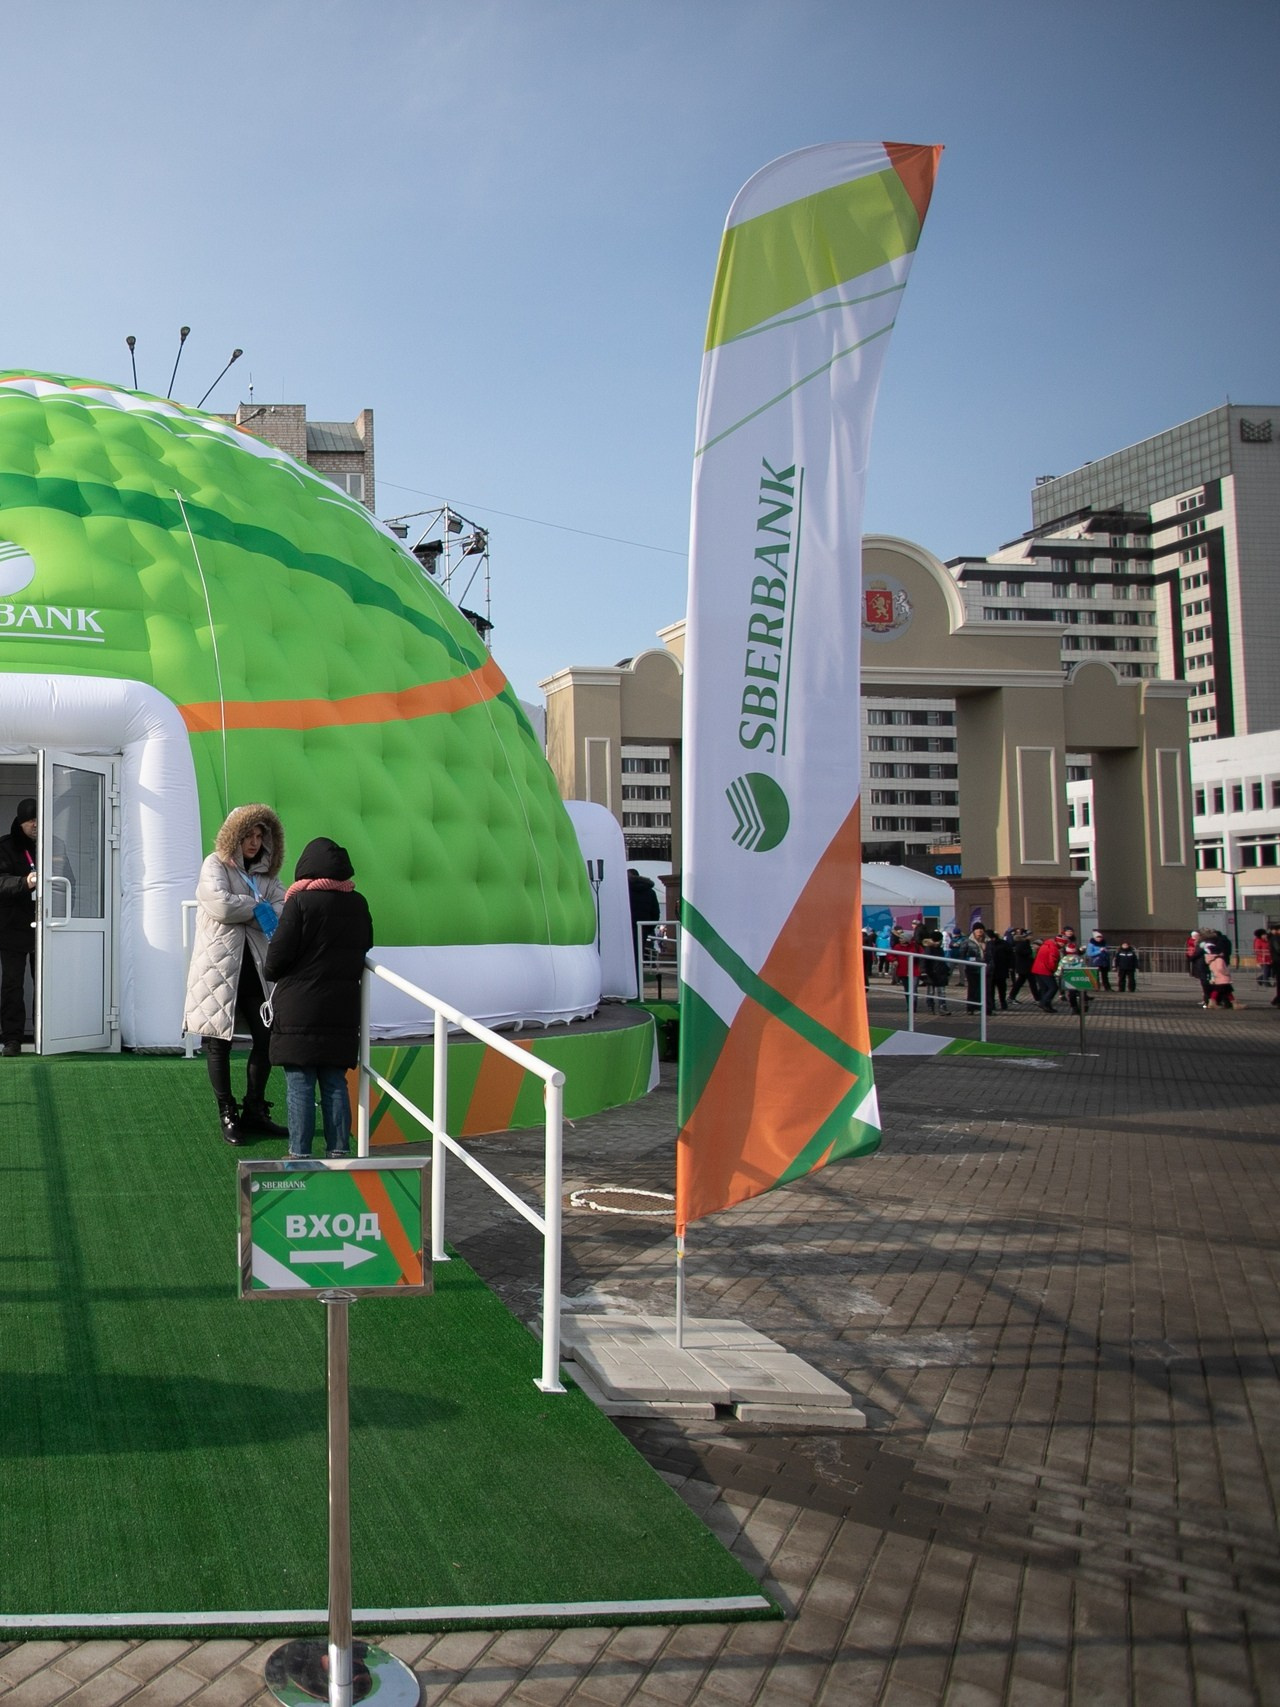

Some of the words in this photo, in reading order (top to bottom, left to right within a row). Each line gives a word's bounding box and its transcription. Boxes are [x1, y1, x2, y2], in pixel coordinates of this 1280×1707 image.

[738, 456, 796, 755] SBERBANK
[261, 1181, 307, 1189] SBERBANK
[286, 1213, 381, 1240] ВХОД
